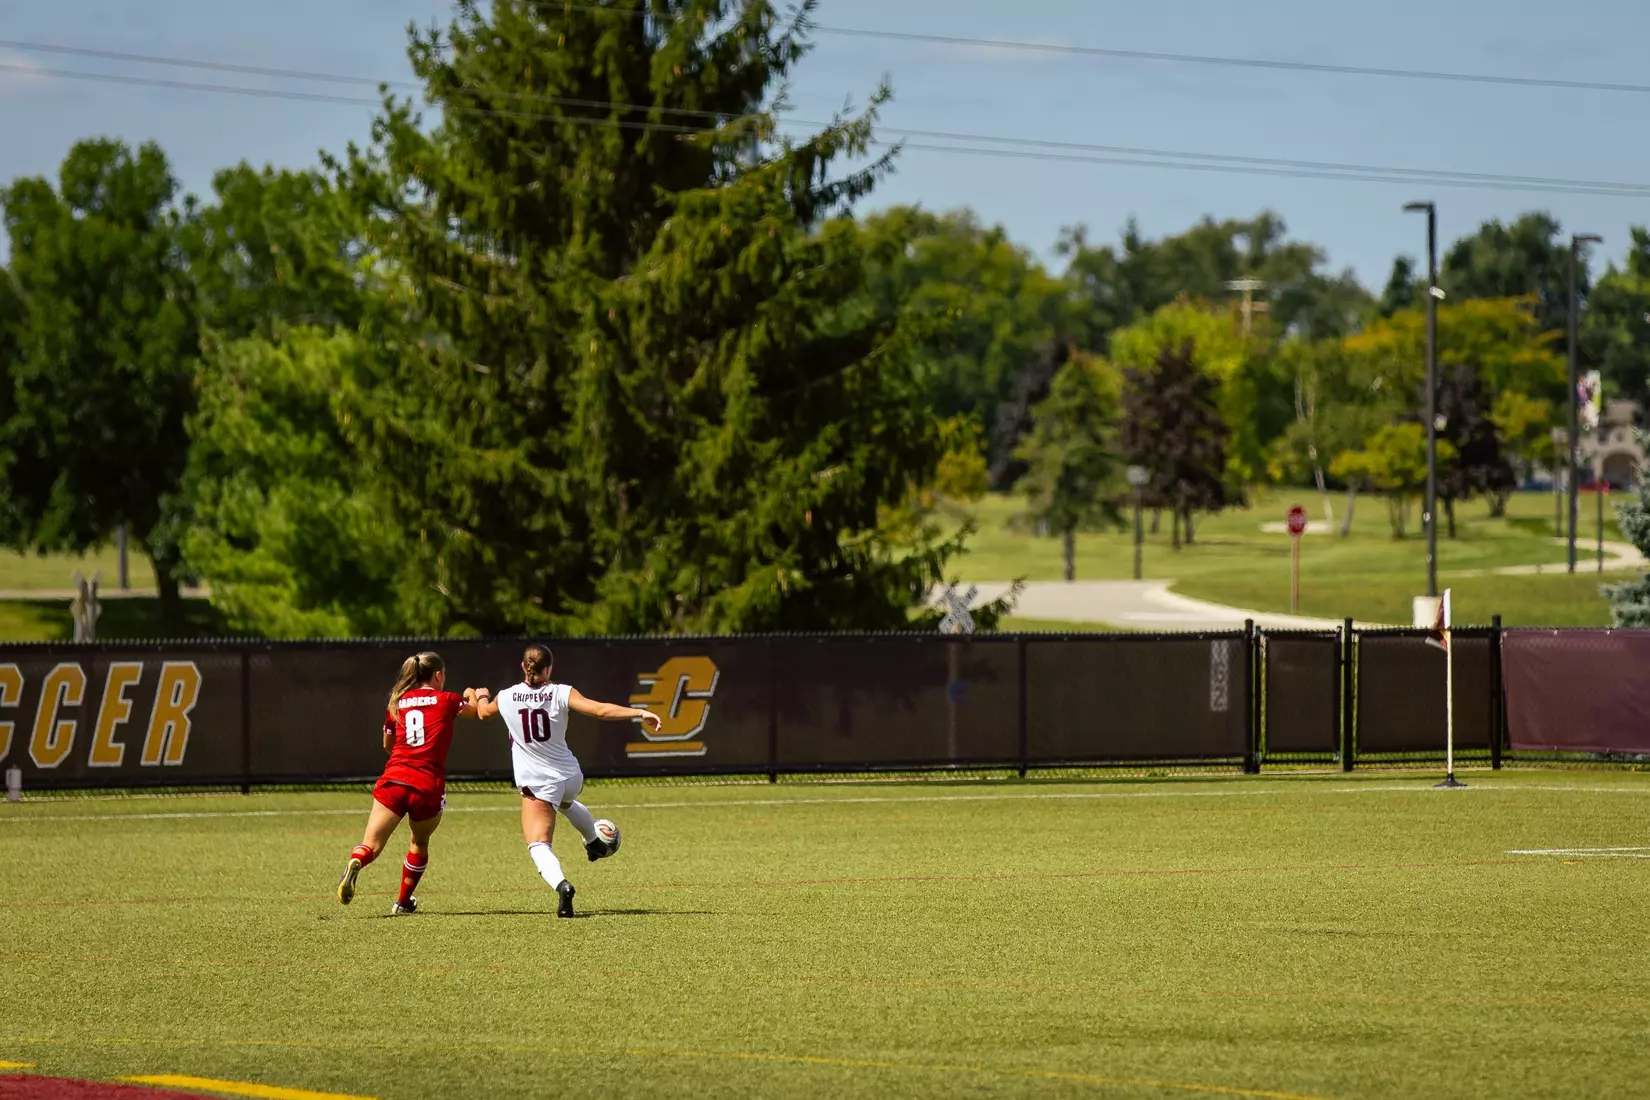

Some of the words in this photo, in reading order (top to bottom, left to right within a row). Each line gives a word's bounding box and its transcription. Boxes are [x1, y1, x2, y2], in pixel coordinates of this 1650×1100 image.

[512, 691, 553, 703] CHIPPEWAS
[405, 709, 425, 747] 8
[518, 708, 551, 744] 10
